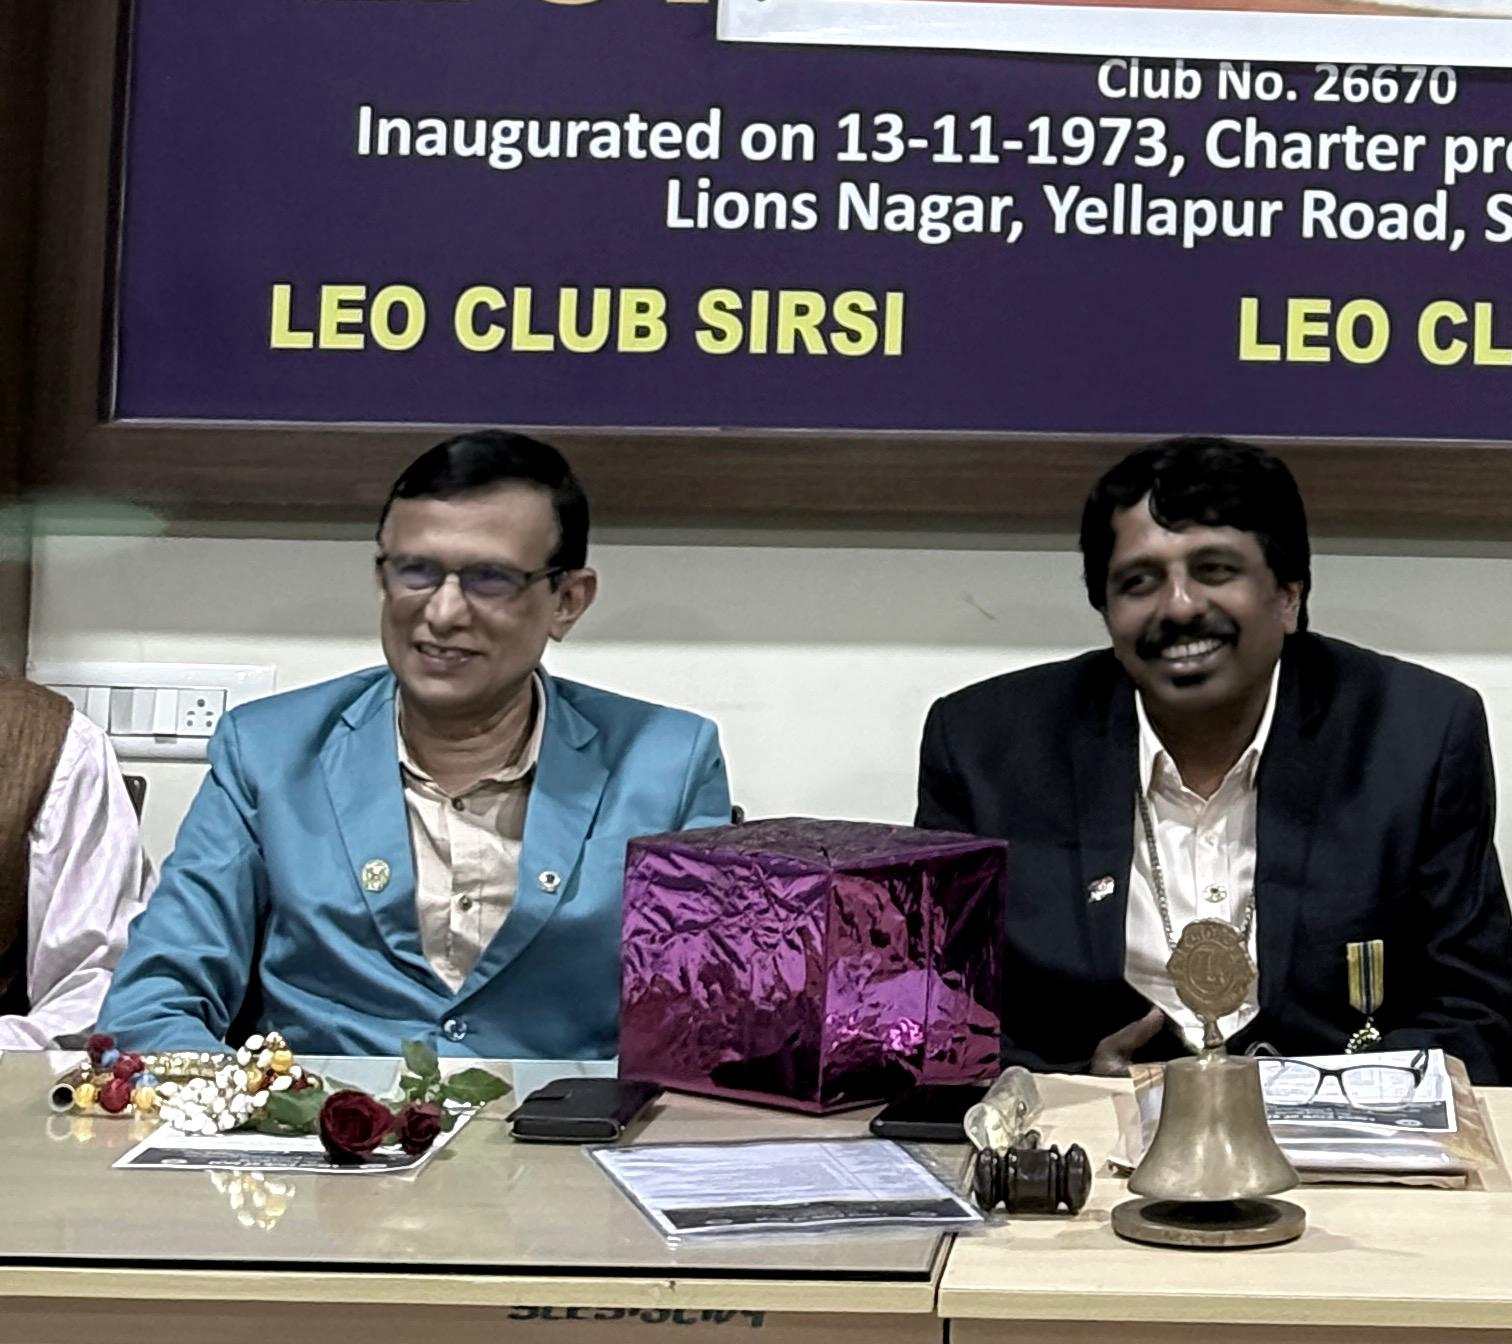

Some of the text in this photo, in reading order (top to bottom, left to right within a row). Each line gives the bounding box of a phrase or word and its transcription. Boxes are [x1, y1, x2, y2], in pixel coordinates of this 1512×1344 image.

[1097, 58, 1457, 105] Club No. 26670
[355, 105, 722, 170] Inaugurated
[740, 121, 815, 162] on
[836, 112, 1186, 177] 13-11-1973,
[1205, 118, 1426, 174] Charter
[666, 178, 818, 231] Lions
[837, 181, 1025, 245] Nagar,
[1042, 183, 1283, 249] Yellapur
[1302, 189, 1467, 252] Road,
[270, 284, 904, 356] LEO CLUB SIRSI
[1238, 297, 1390, 363] LEO
